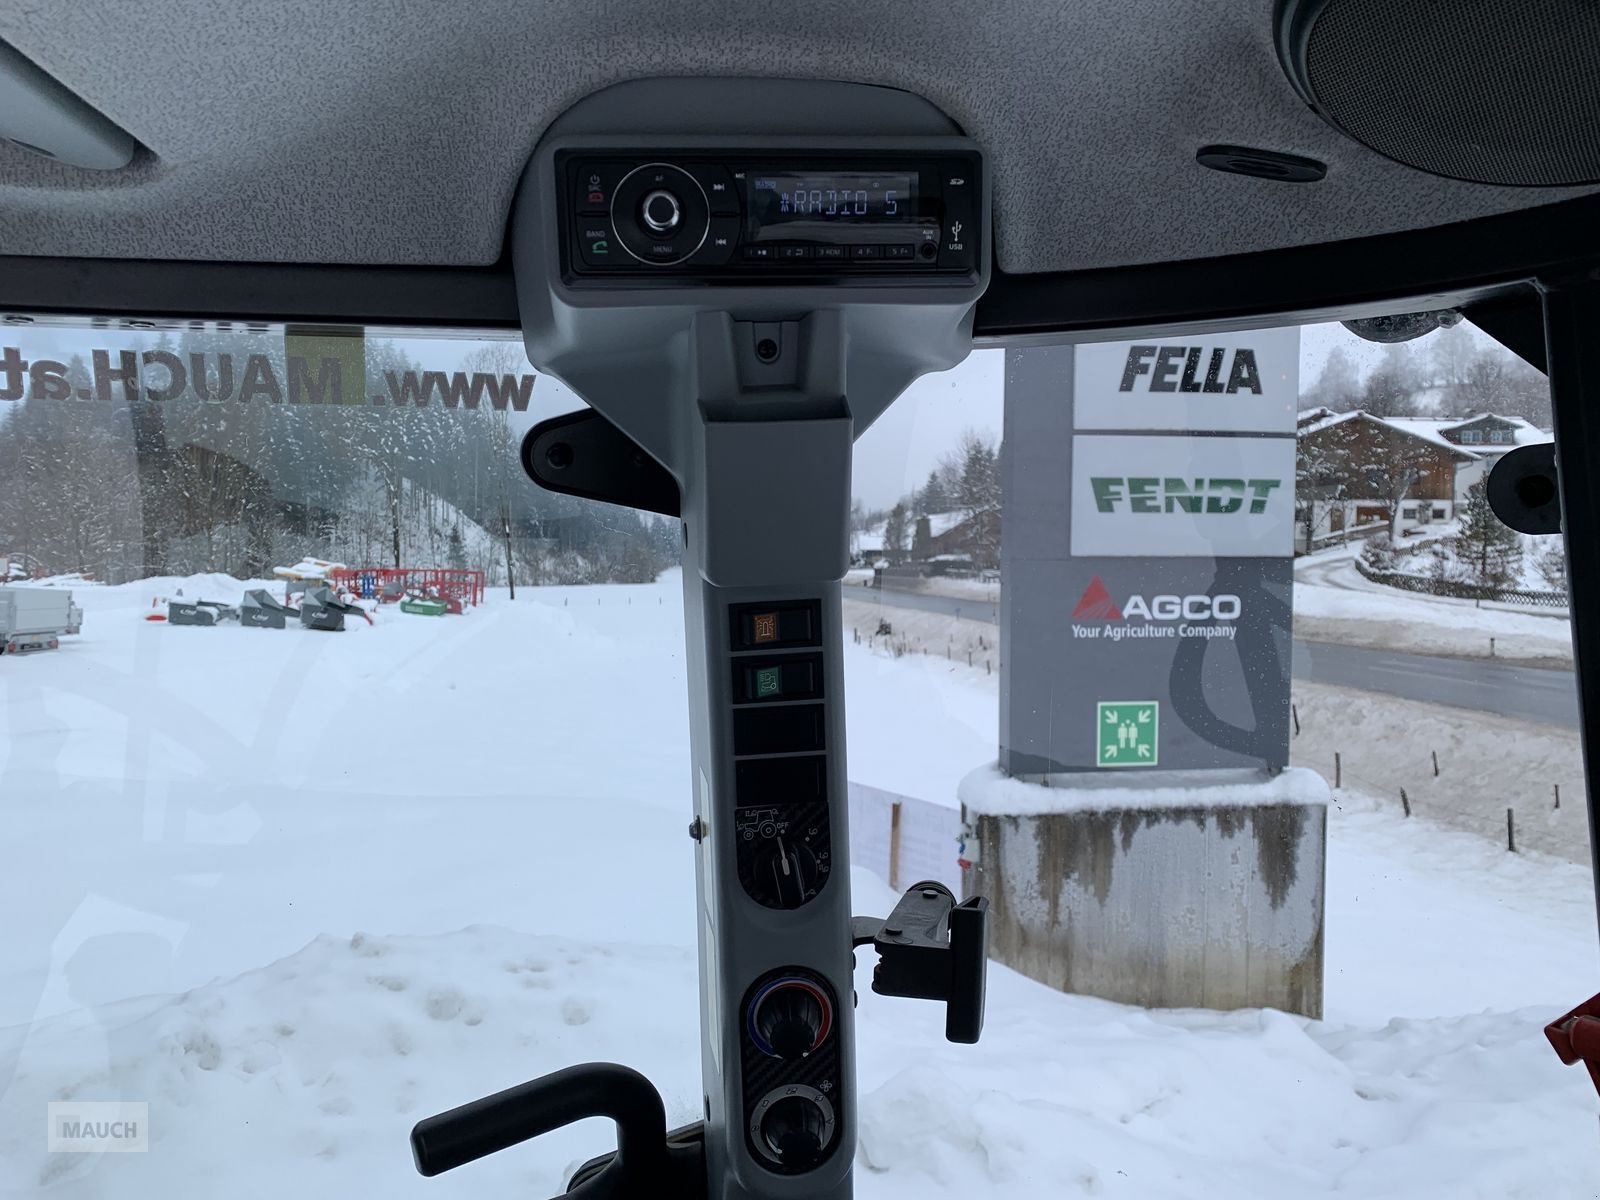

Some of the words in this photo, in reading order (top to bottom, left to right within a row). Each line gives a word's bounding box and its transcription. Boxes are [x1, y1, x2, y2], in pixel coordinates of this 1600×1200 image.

[794, 190, 867, 214] RADIO
[1118, 345, 1263, 394] FELLA
[1090, 477, 1281, 514] FENDT
[1121, 595, 1242, 621] AGCO
[1072, 625, 1101, 639] Your
[1103, 624, 1176, 641] Agriculture
[1178, 624, 1237, 640] Company
